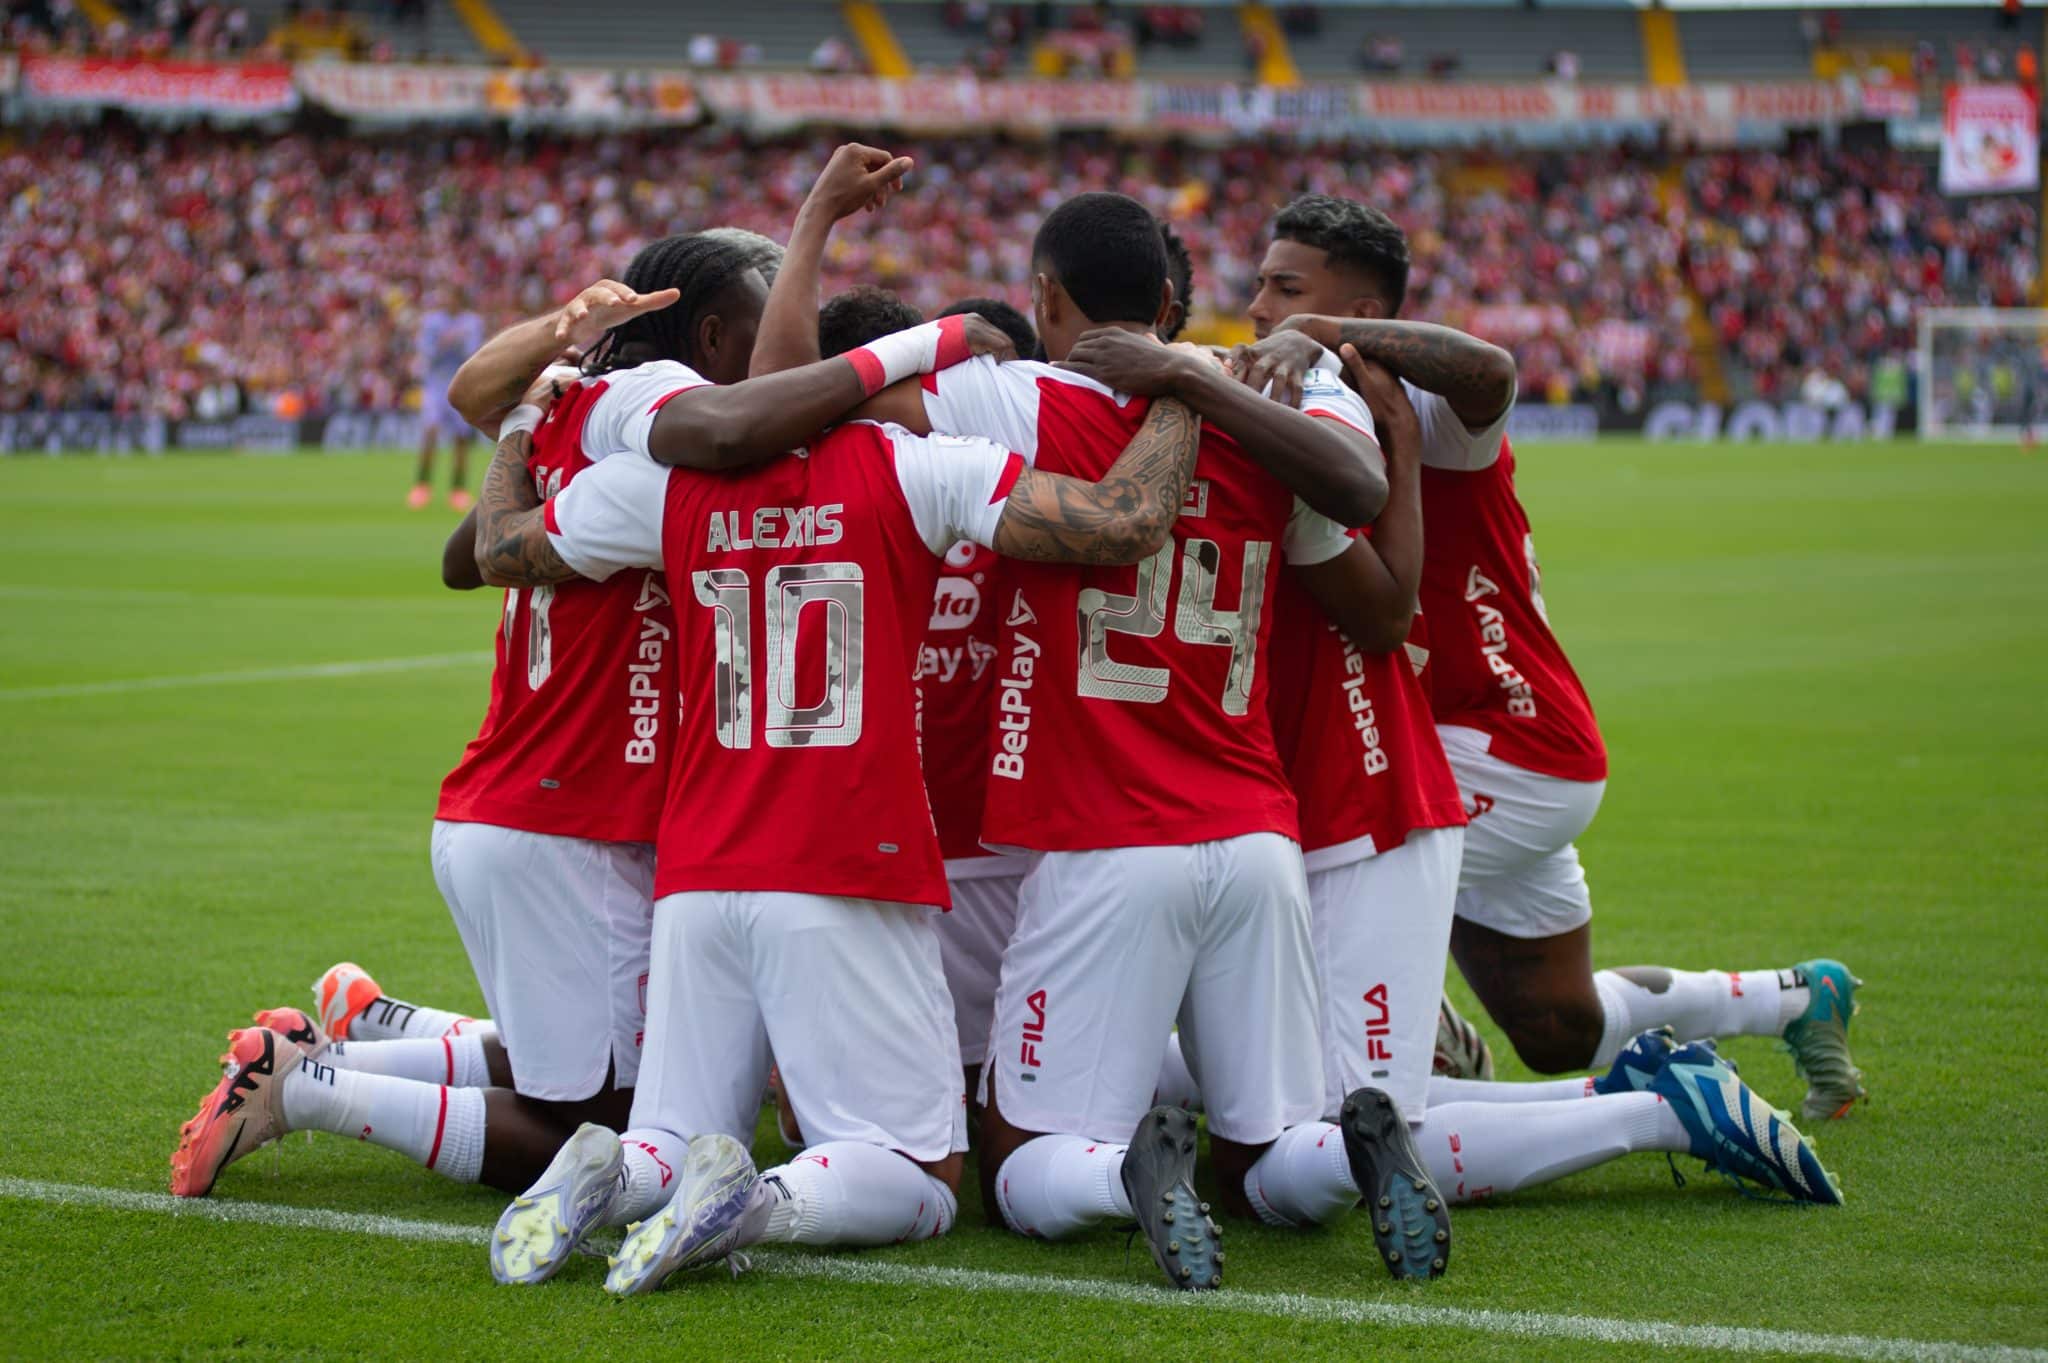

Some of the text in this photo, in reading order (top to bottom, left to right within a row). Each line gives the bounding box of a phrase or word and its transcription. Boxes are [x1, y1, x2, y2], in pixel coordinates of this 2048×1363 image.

[707, 503, 844, 552] ALEXIS
[625, 617, 670, 763] BetPlay
[691, 562, 865, 749] 10
[1077, 534, 1272, 716] 24
[993, 632, 1041, 781] BetPlay
[1021, 990, 1046, 1067] FILA
[1363, 983, 1392, 1060] FILA
